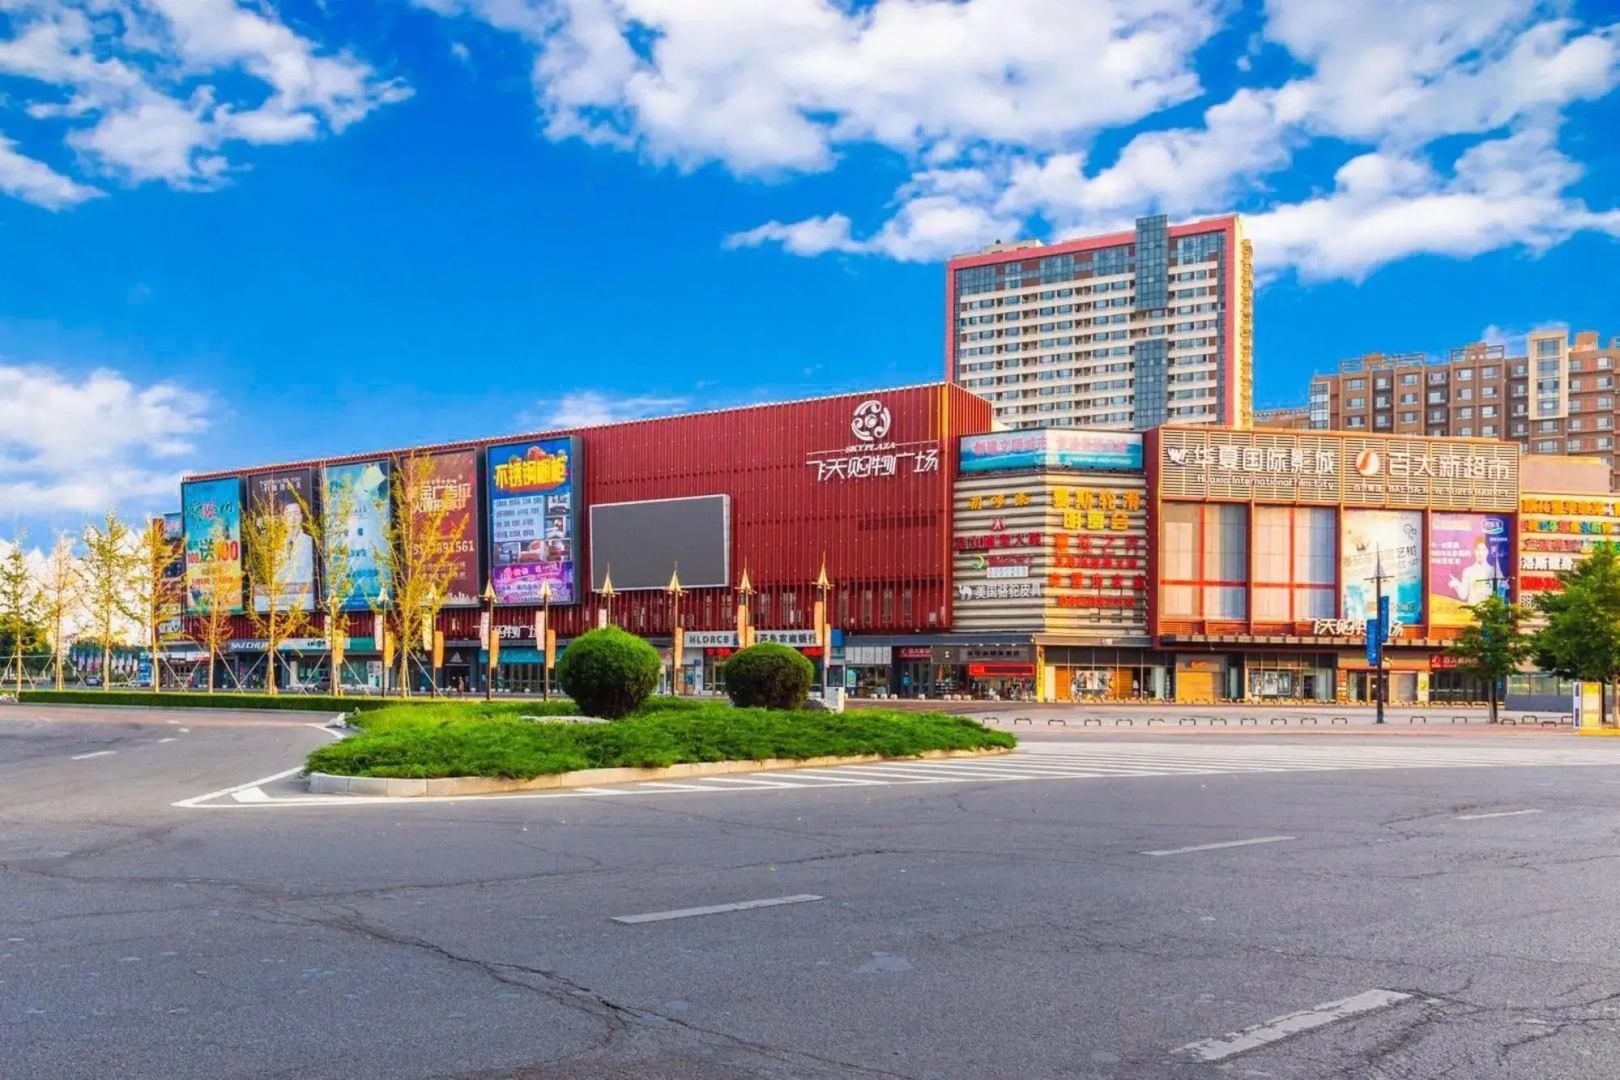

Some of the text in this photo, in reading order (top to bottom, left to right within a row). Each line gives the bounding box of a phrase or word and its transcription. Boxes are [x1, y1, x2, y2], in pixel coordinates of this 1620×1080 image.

[806, 450, 938, 481] 飞天购物广场
[1194, 445, 1335, 474] 华夏国际影城
[1389, 453, 1510, 480] 百大新超市
[975, 582, 1041, 599] 美国骆驼皮具
[230, 641, 270, 650] SKECHER
